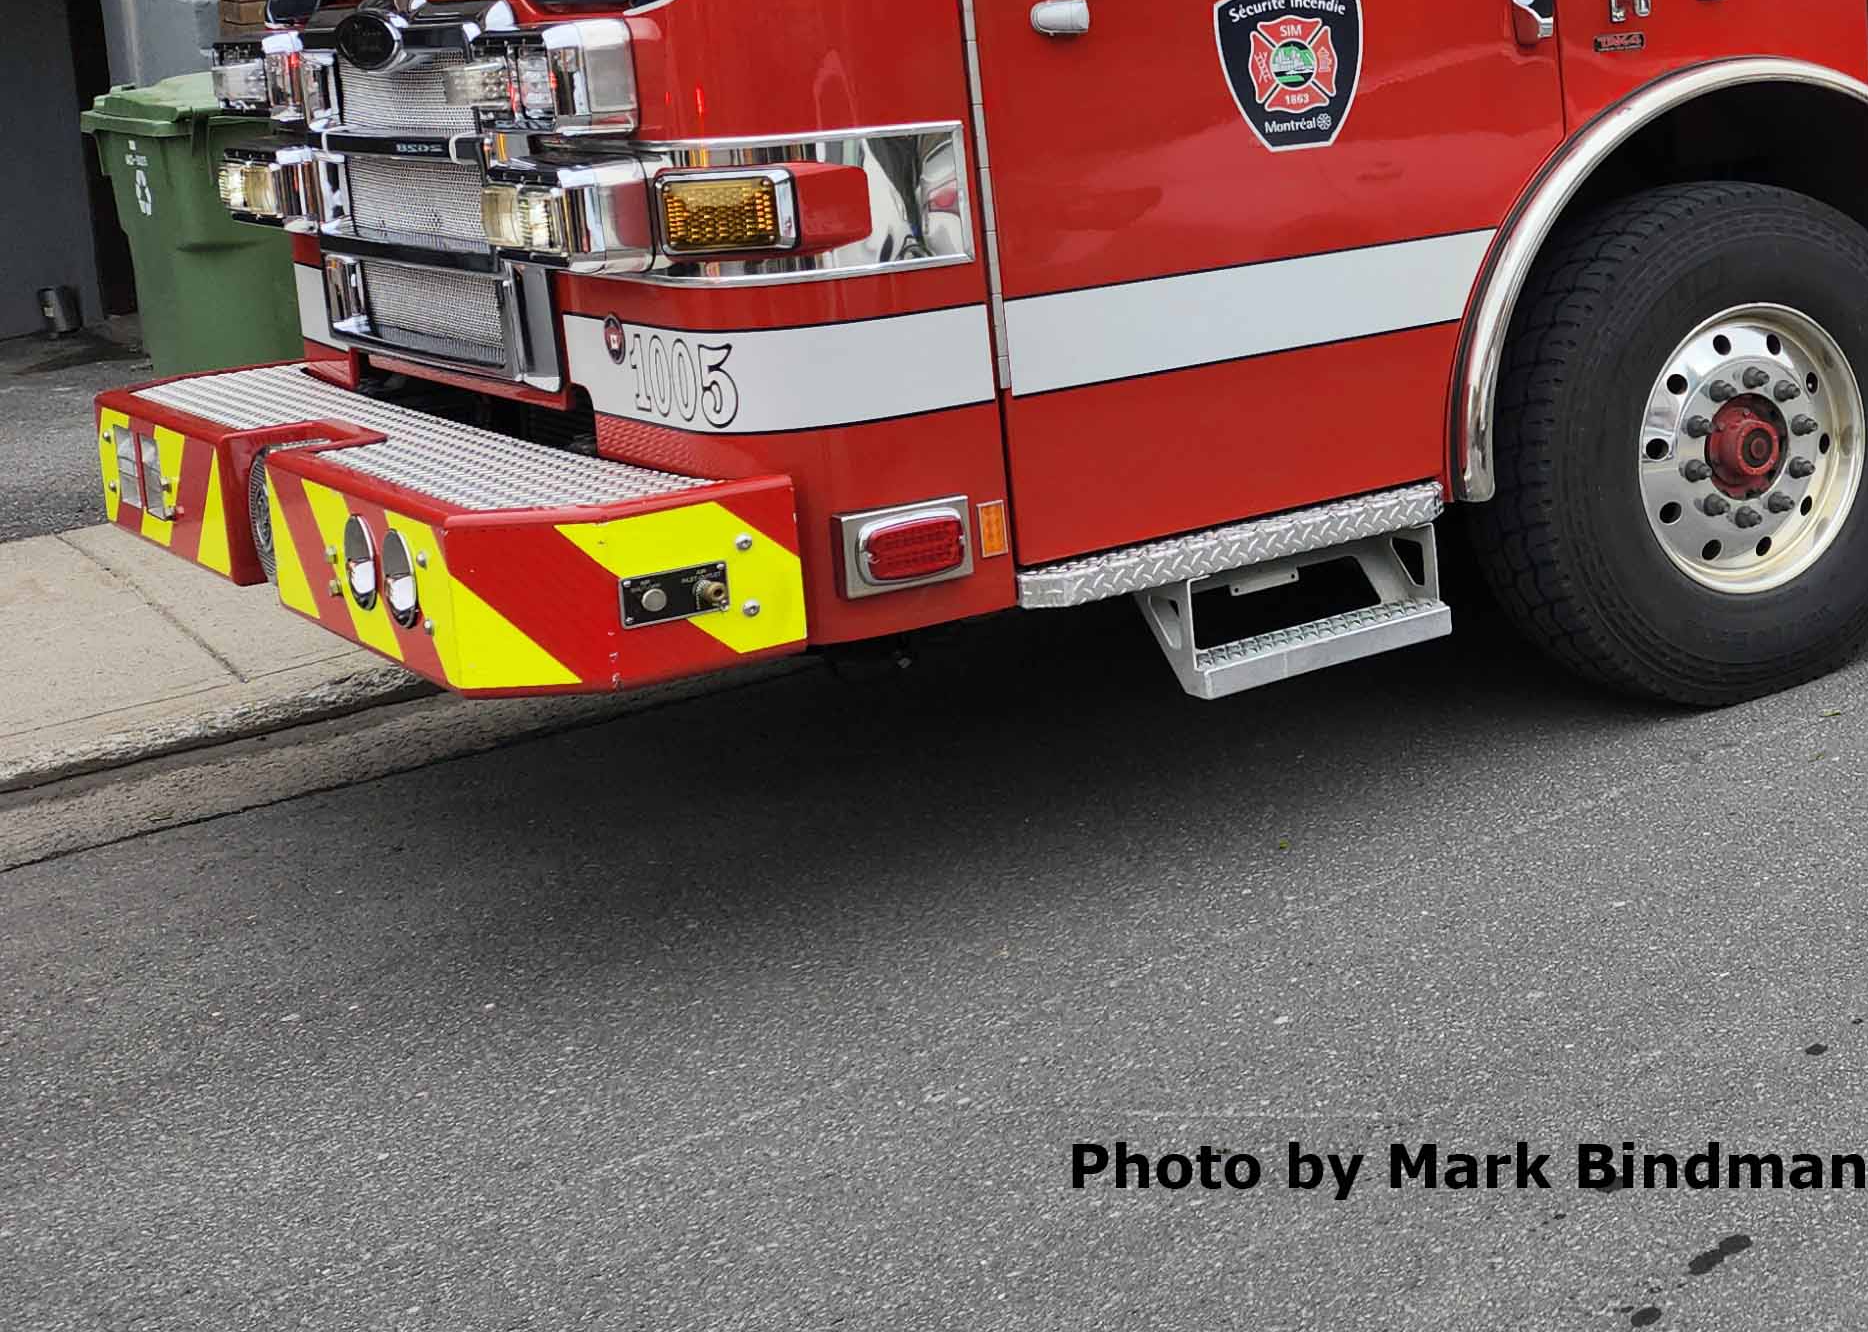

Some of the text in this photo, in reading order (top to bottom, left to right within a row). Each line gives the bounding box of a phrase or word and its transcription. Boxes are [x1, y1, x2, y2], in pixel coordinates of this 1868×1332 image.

[1279, 24, 1303, 38] SIM
[1285, 94, 1310, 105] 1863
[1264, 118, 1316, 134] Montréal
[630, 333, 739, 428] 1005
